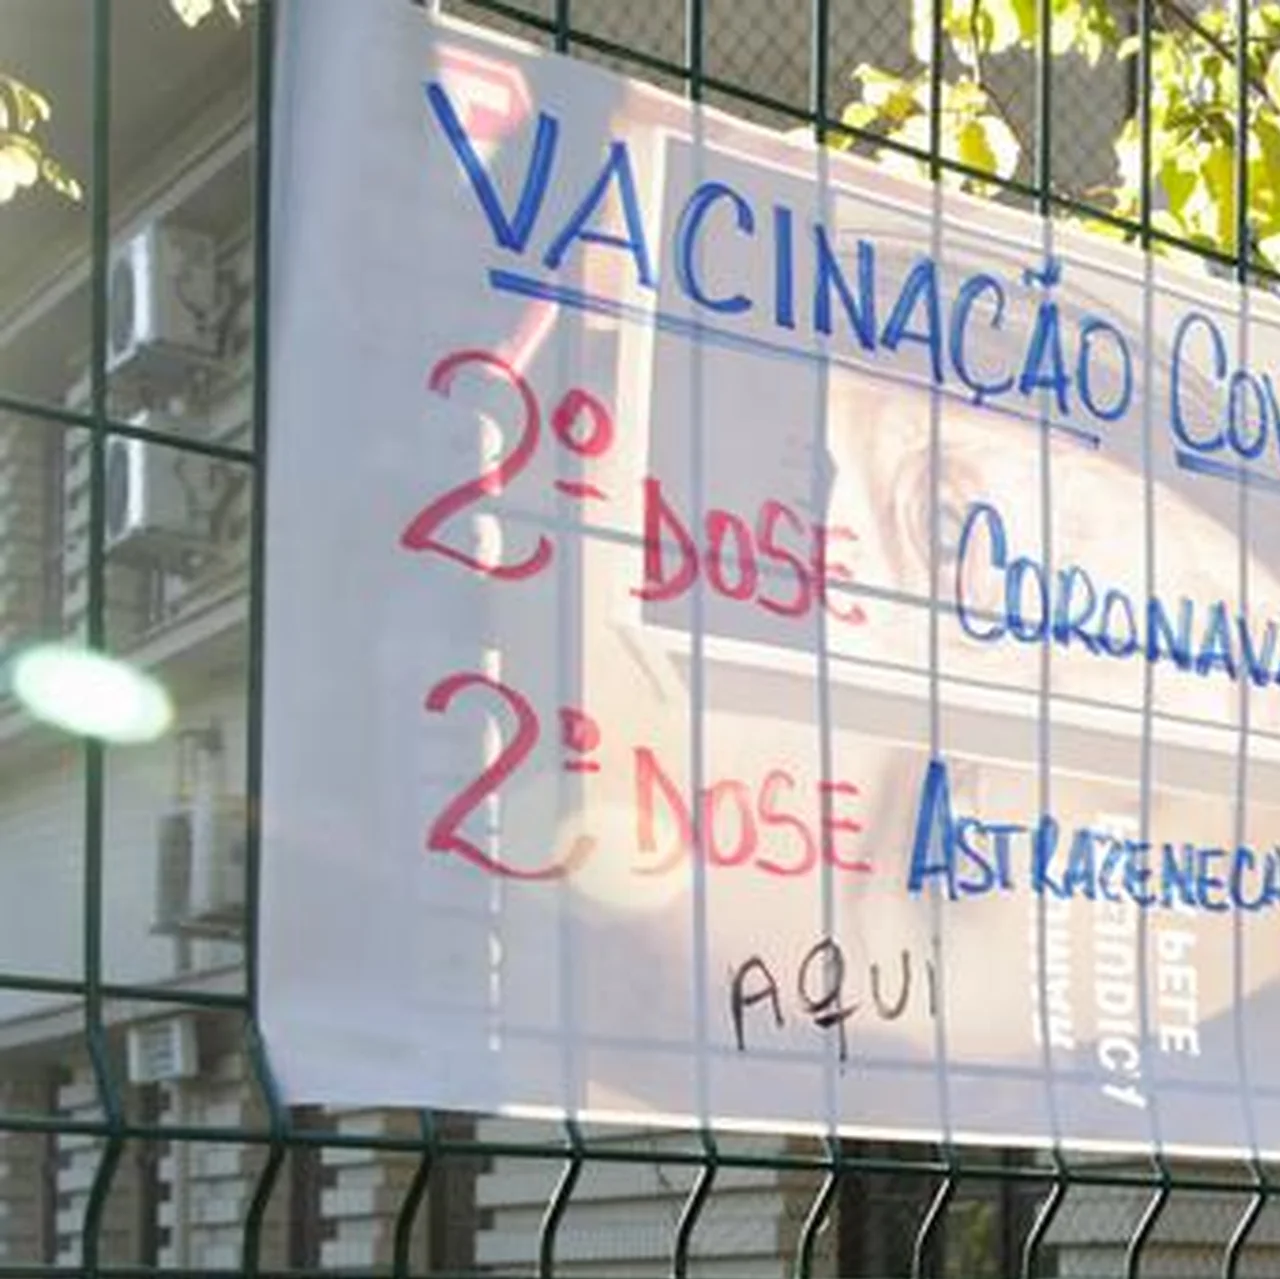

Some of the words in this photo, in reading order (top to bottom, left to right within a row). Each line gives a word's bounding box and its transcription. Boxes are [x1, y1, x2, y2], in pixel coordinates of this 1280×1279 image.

[426, 79, 1132, 423] VACINAÇÃO
[630, 477, 868, 626] DOSE
[630, 745, 873, 877] DOSE
